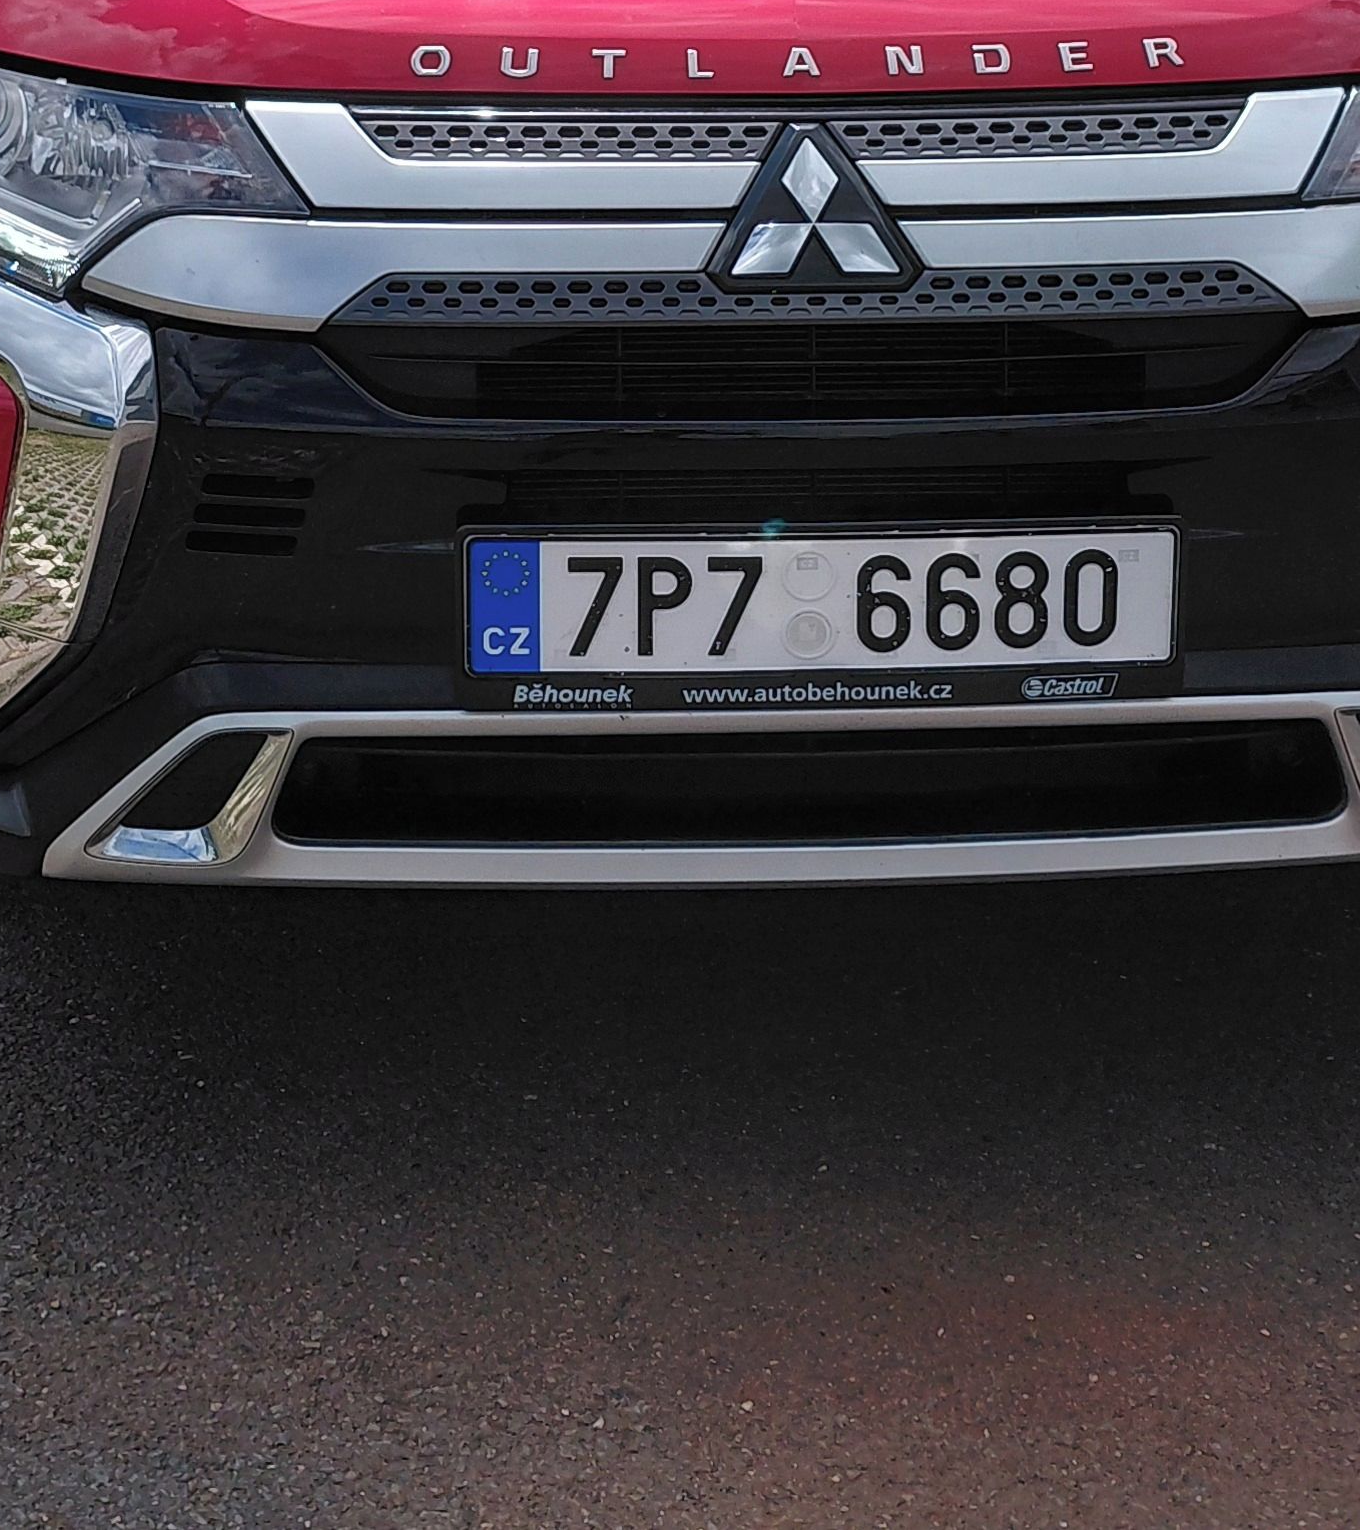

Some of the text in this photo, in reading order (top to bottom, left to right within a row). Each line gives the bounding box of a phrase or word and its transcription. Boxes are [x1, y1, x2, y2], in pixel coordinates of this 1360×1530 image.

[410, 36, 1184, 79] OUTLANDER
[482, 549, 1119, 657] CZ 7P7 6680
[513, 682, 634, 703] Běhounek
[682, 680, 953, 703] www.autobehounek.cz
[1043, 677, 1105, 696] Castrol
